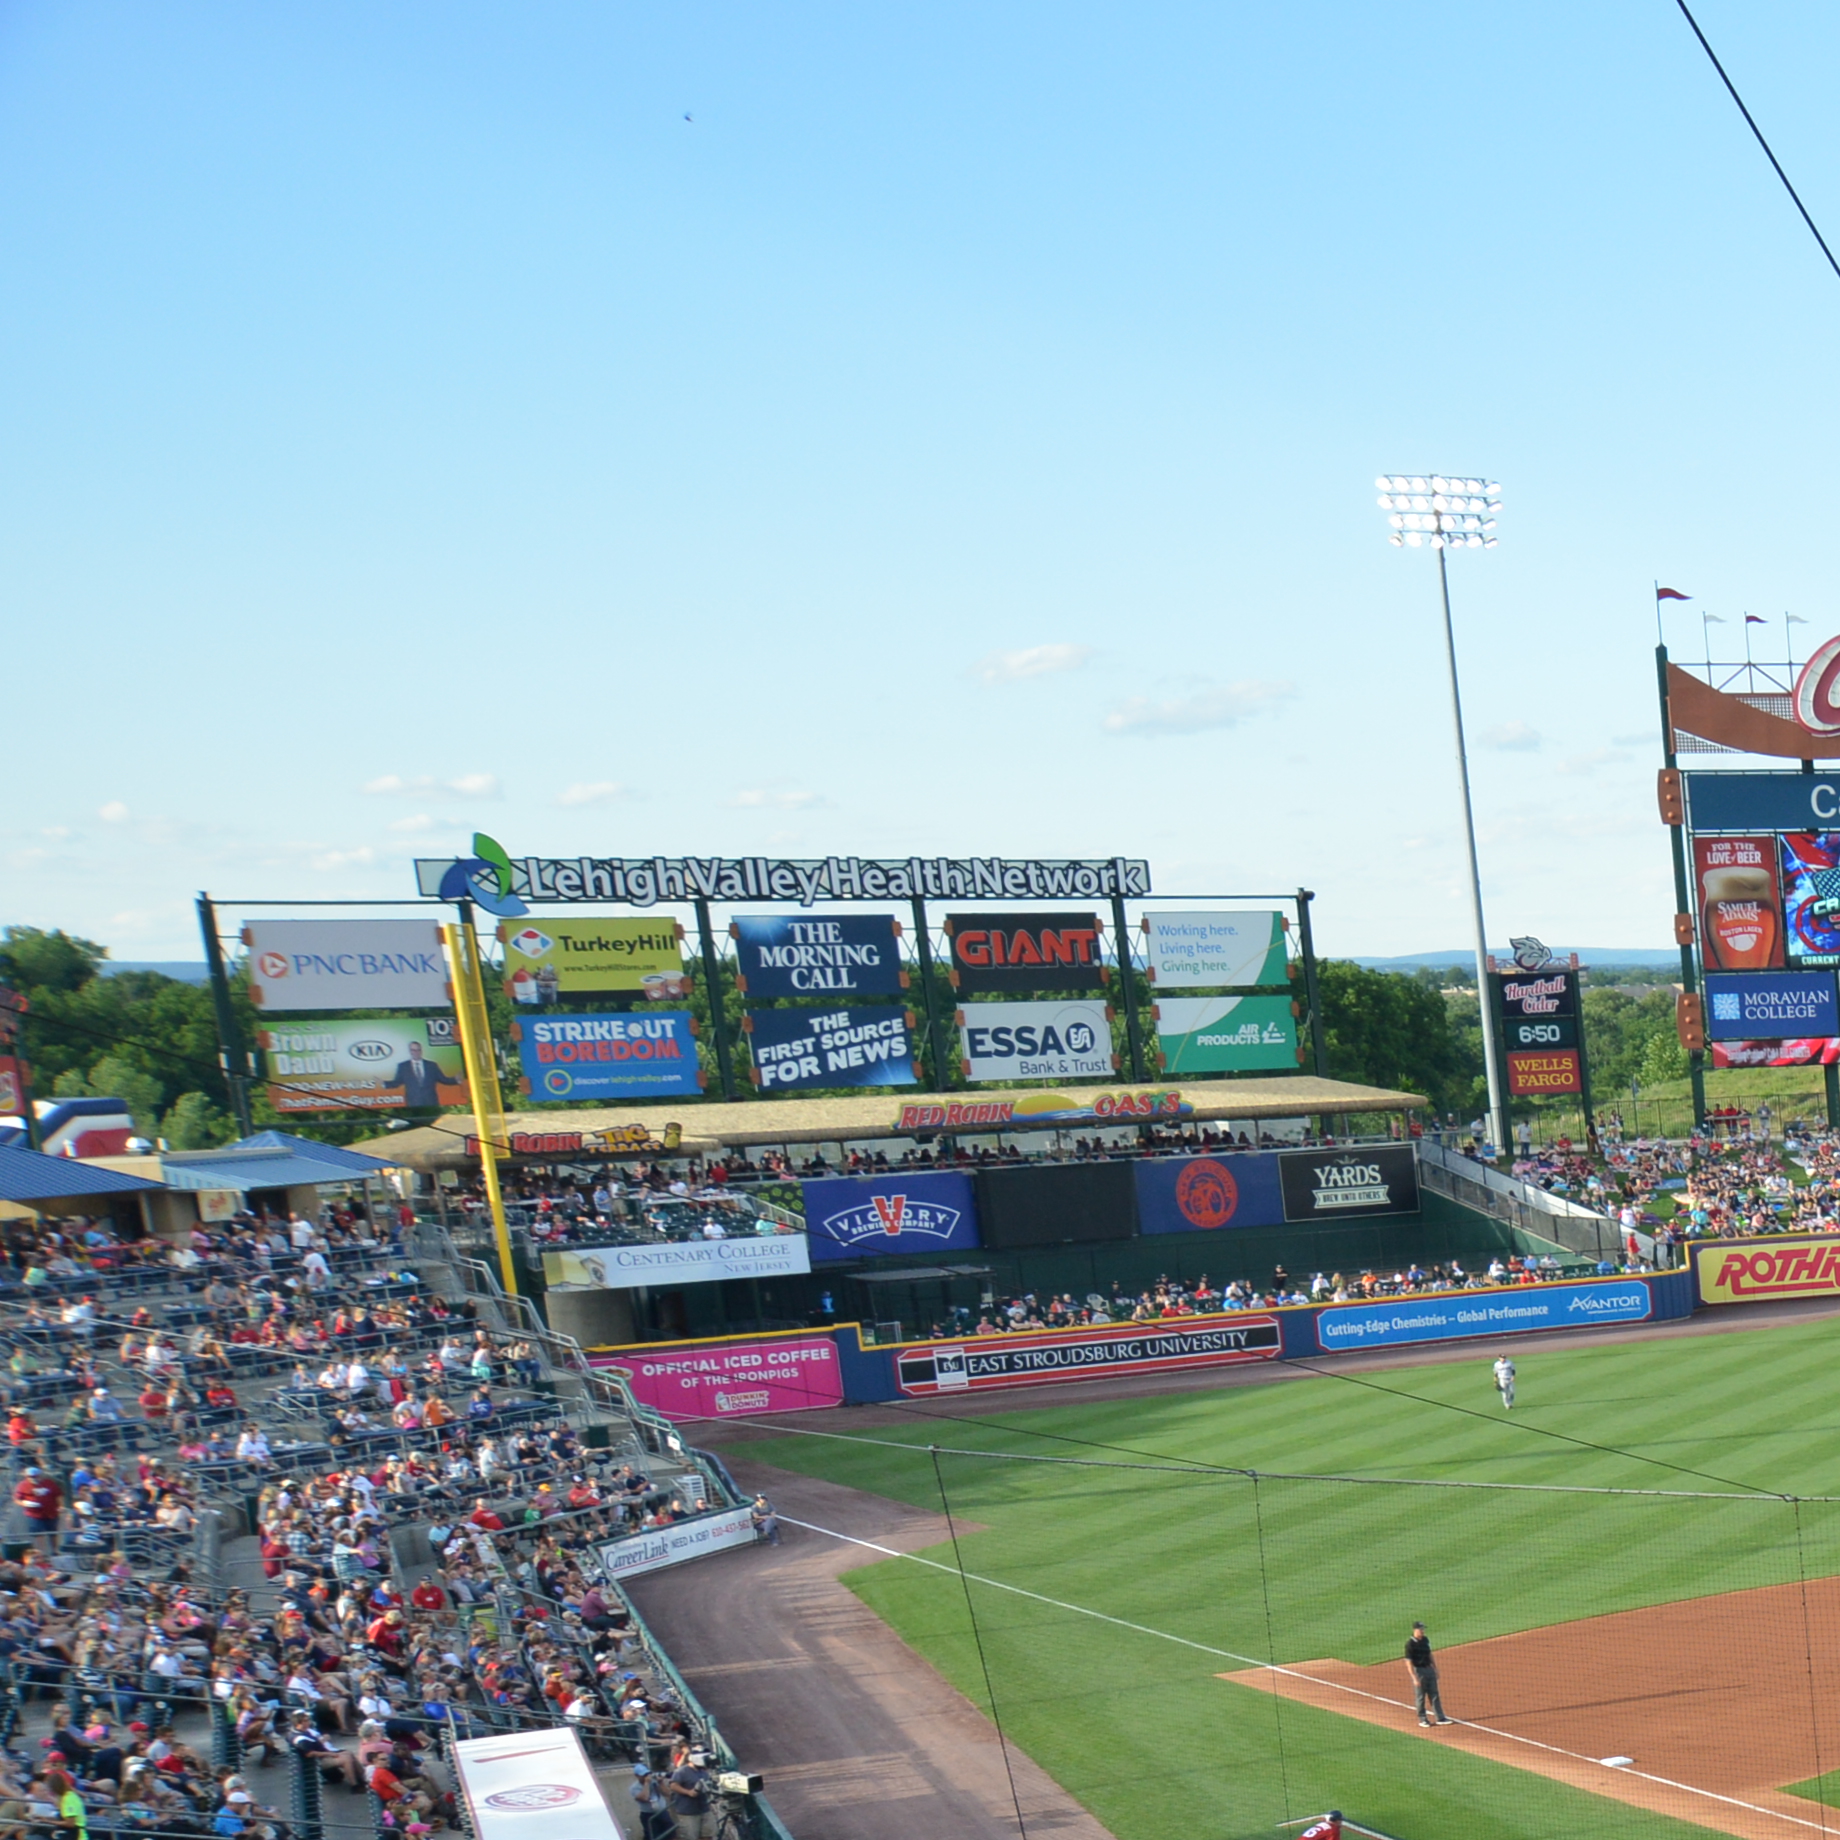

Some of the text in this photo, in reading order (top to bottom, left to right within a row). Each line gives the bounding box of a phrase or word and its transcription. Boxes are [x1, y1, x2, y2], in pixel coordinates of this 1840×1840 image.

[527, 857, 1143, 907] Lehigh Valley Health Network
[788, 922, 843, 944] THE
[1158, 923, 1239, 941] Working here.
[758, 945, 880, 967] MORNING
[956, 929, 1096, 969] GIANT
[1160, 942, 1226, 958] Living here.
[1162, 959, 1231, 976] Giving here.
[791, 967, 857, 990] CALL
[1505, 976, 1566, 1000] Hardball
[1522, 997, 1559, 1014] Cider
[1744, 990, 1829, 1006] MORAVIAN
[809, 1012, 850, 1033] THE
[1745, 1005, 1816, 1020] COLLEGE
[1238, 1024, 1260, 1035] AIR
[1519, 1025, 1561, 1043] 6:50
[757, 1018, 905, 1063] FIRST SOURCE
[967, 1025, 1066, 1058] ESSA
[1197, 1034, 1260, 1047] PRODUCTS
[760, 1036, 907, 1087] FOR NEWS
[1020, 1058, 1107, 1075] Bank & Trust
[1514, 1058, 1573, 1072] WELLS
[1517, 1073, 1574, 1088] FARGO
[1314, 1164, 1382, 1188] YARDS
[617, 1243, 791, 1269] CENTENARY COLLEGE
[724, 1260, 791, 1274] NEW JERSEY
[969, 1329, 1249, 1373] EAST STROUDSBURG UNIVERSITY
[642, 1348, 831, 1377] OFFICIAL ICED COFFEE
[681, 1368, 799, 1389] OF THE IRONPIGS
